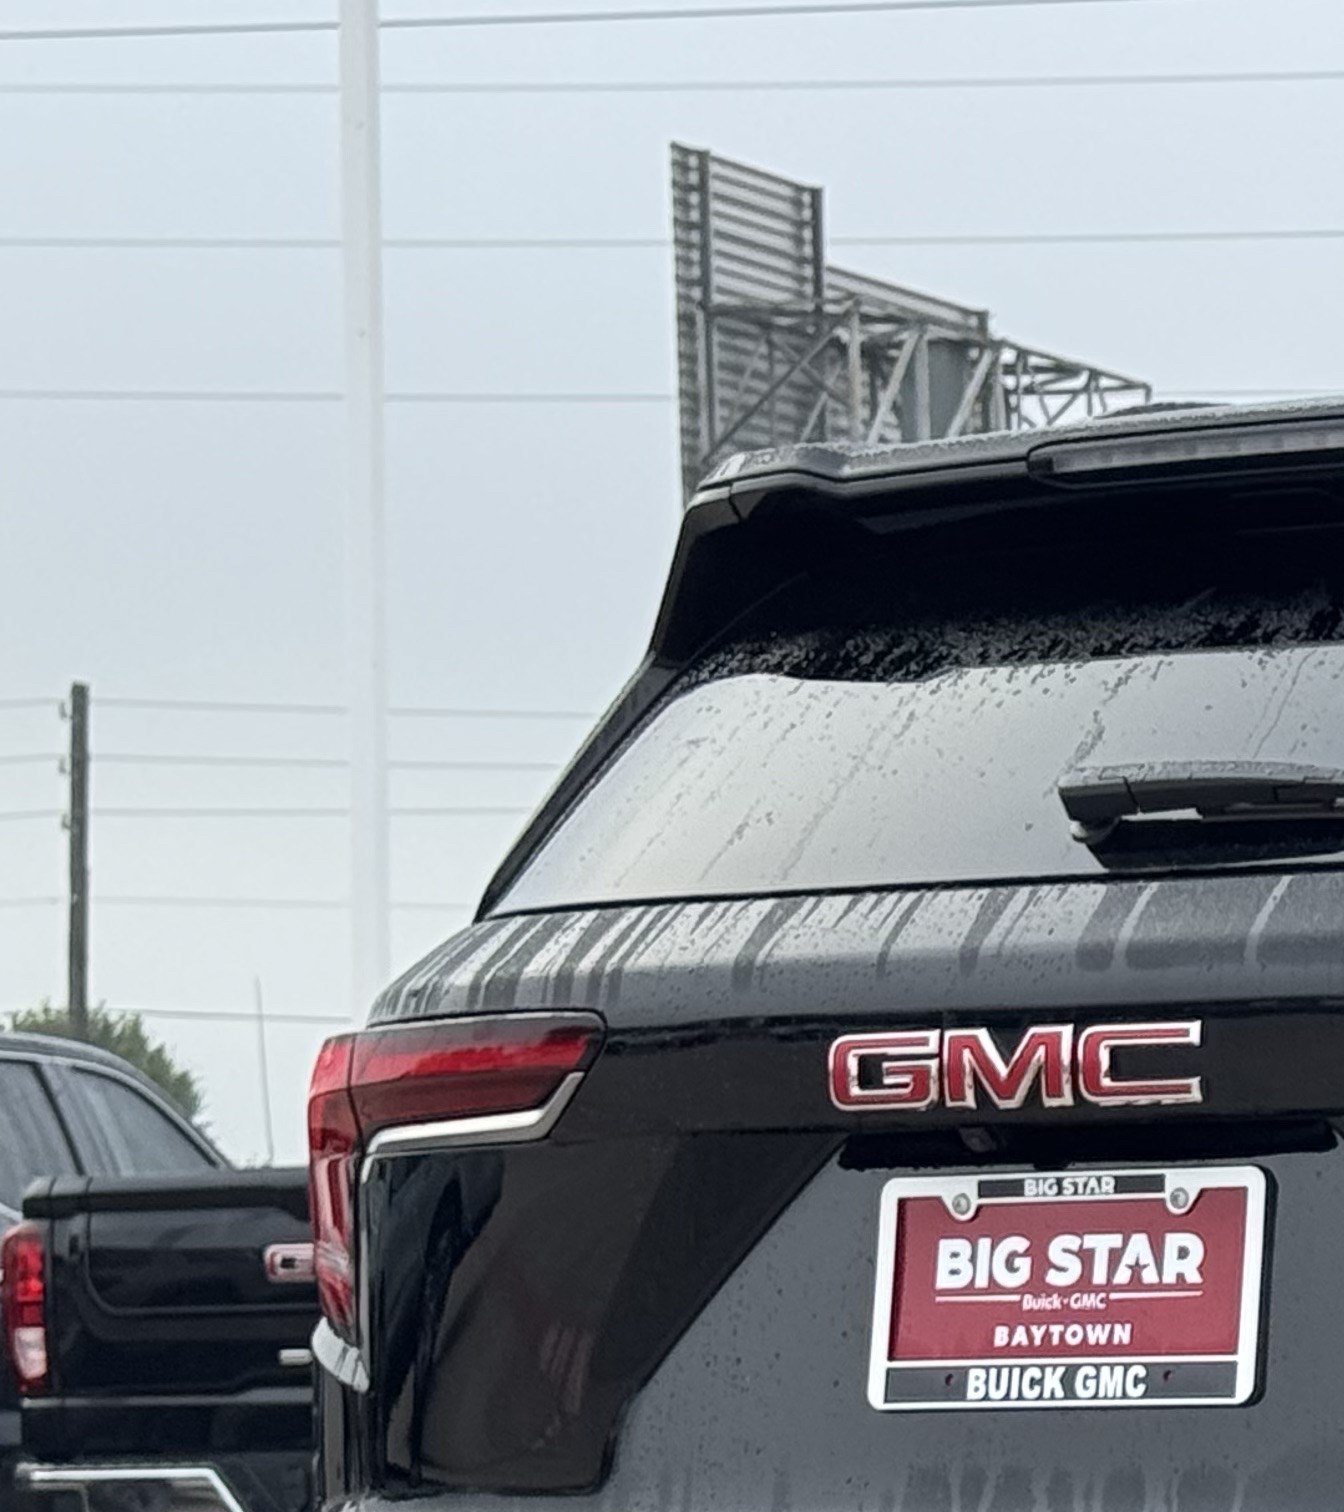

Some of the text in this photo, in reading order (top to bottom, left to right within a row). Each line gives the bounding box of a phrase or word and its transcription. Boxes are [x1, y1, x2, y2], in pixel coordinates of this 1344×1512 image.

[829, 1020, 1202, 1110] GMC
[1024, 1176, 1116, 1196] BIG STAR
[935, 1233, 1205, 1290] BIG STAR
[993, 1323, 1132, 1347] BAYTOWN
[966, 1364, 1148, 1401] BUICK GMC
